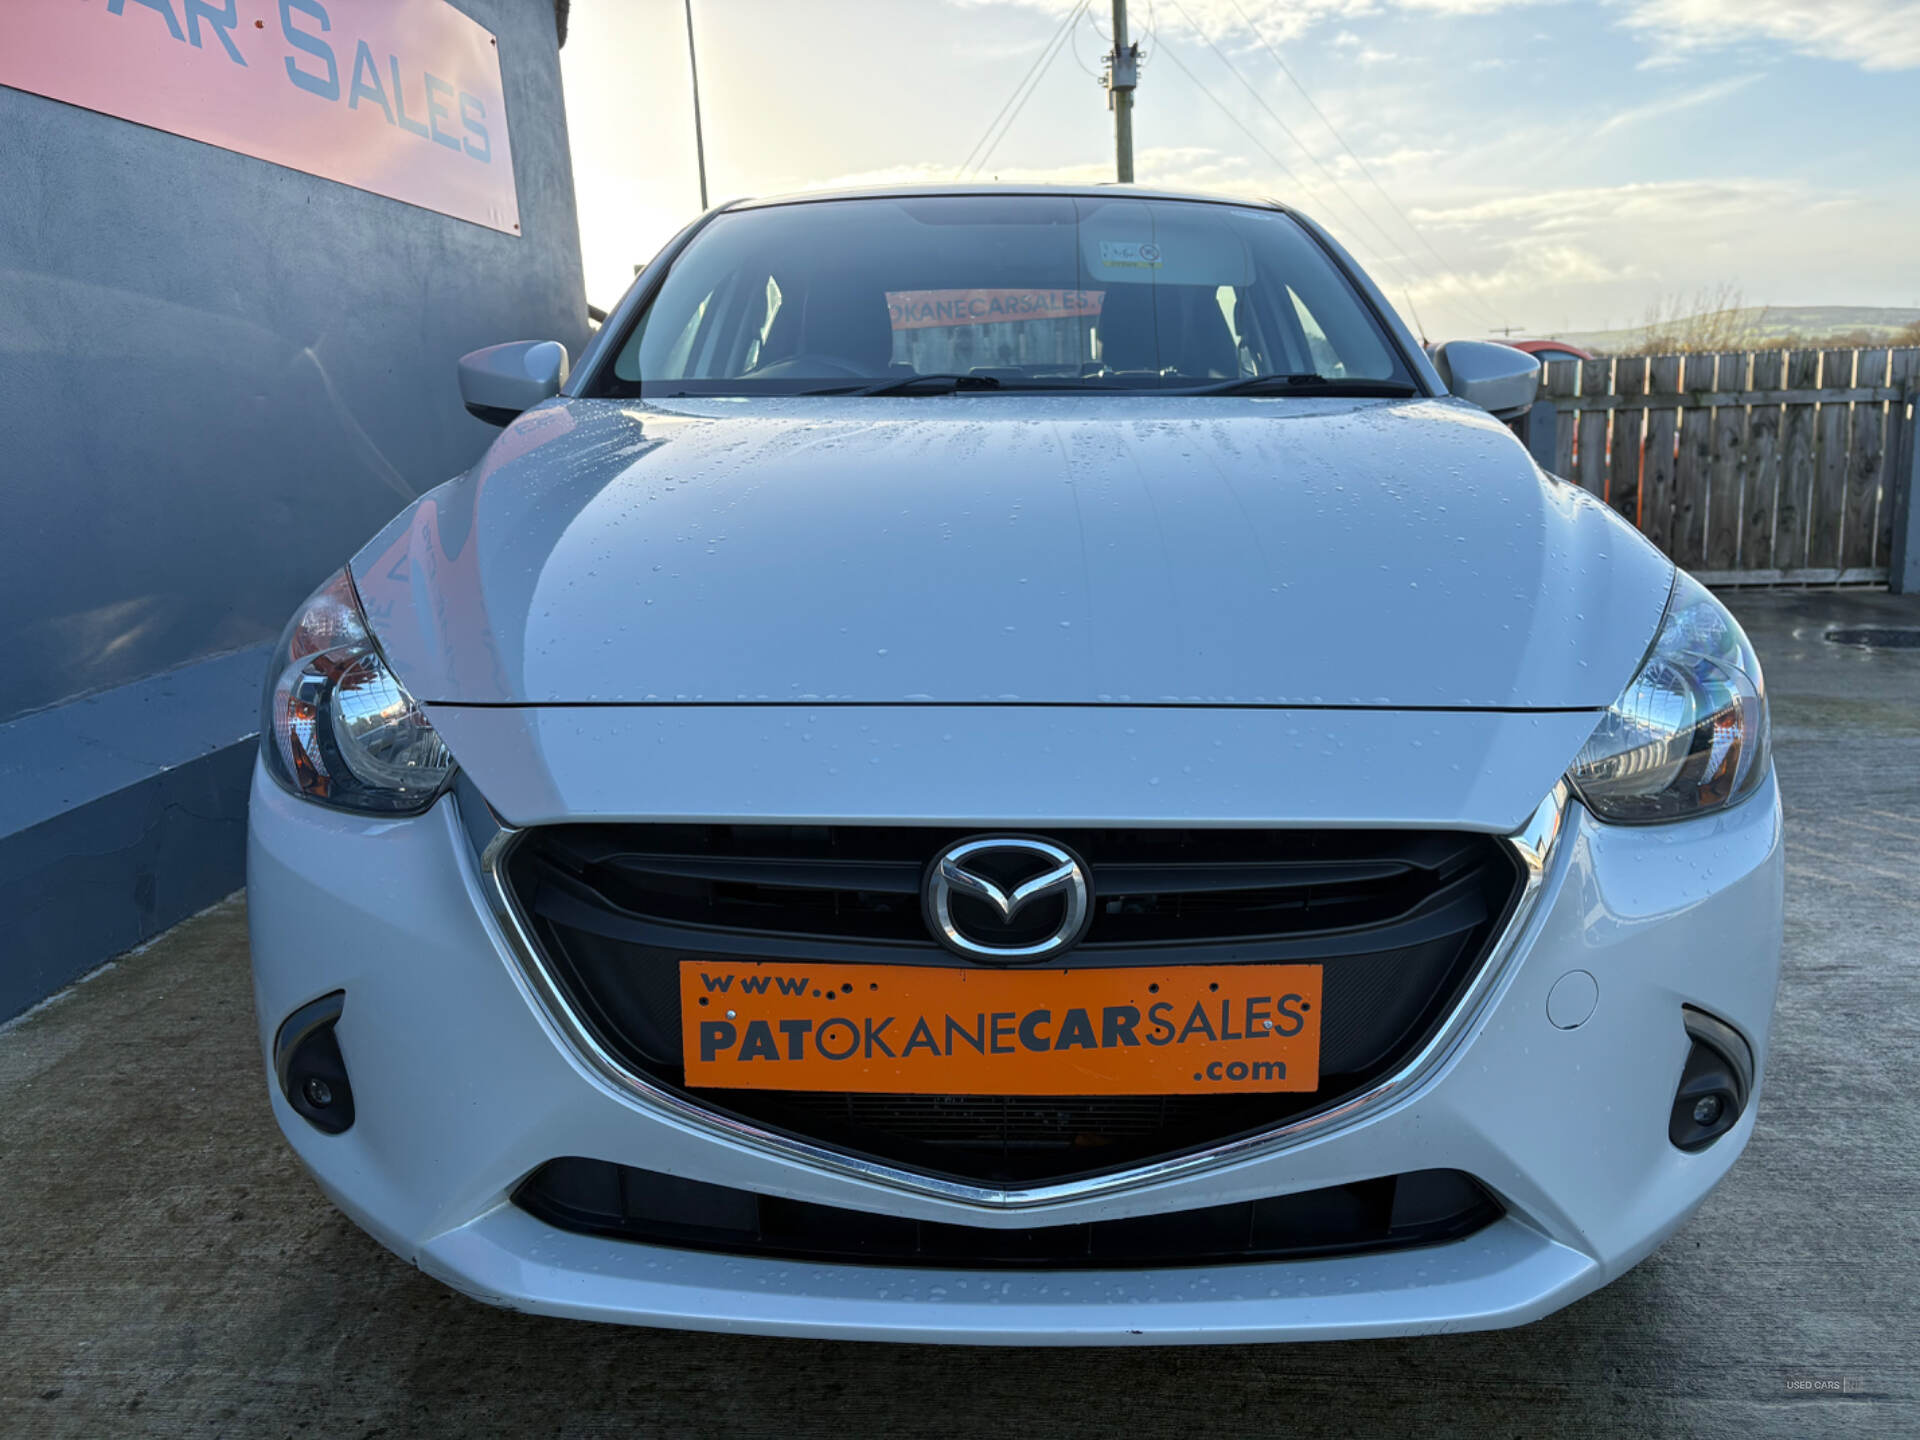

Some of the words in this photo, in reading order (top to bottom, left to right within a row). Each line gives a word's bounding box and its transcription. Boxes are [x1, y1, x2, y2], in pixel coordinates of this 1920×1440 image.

[107, 0, 248, 67] AR
[278, 0, 491, 164] SALES
[700, 993, 1304, 1062] PATOKANECARSALES
[1193, 1061, 1287, 1081] .com
